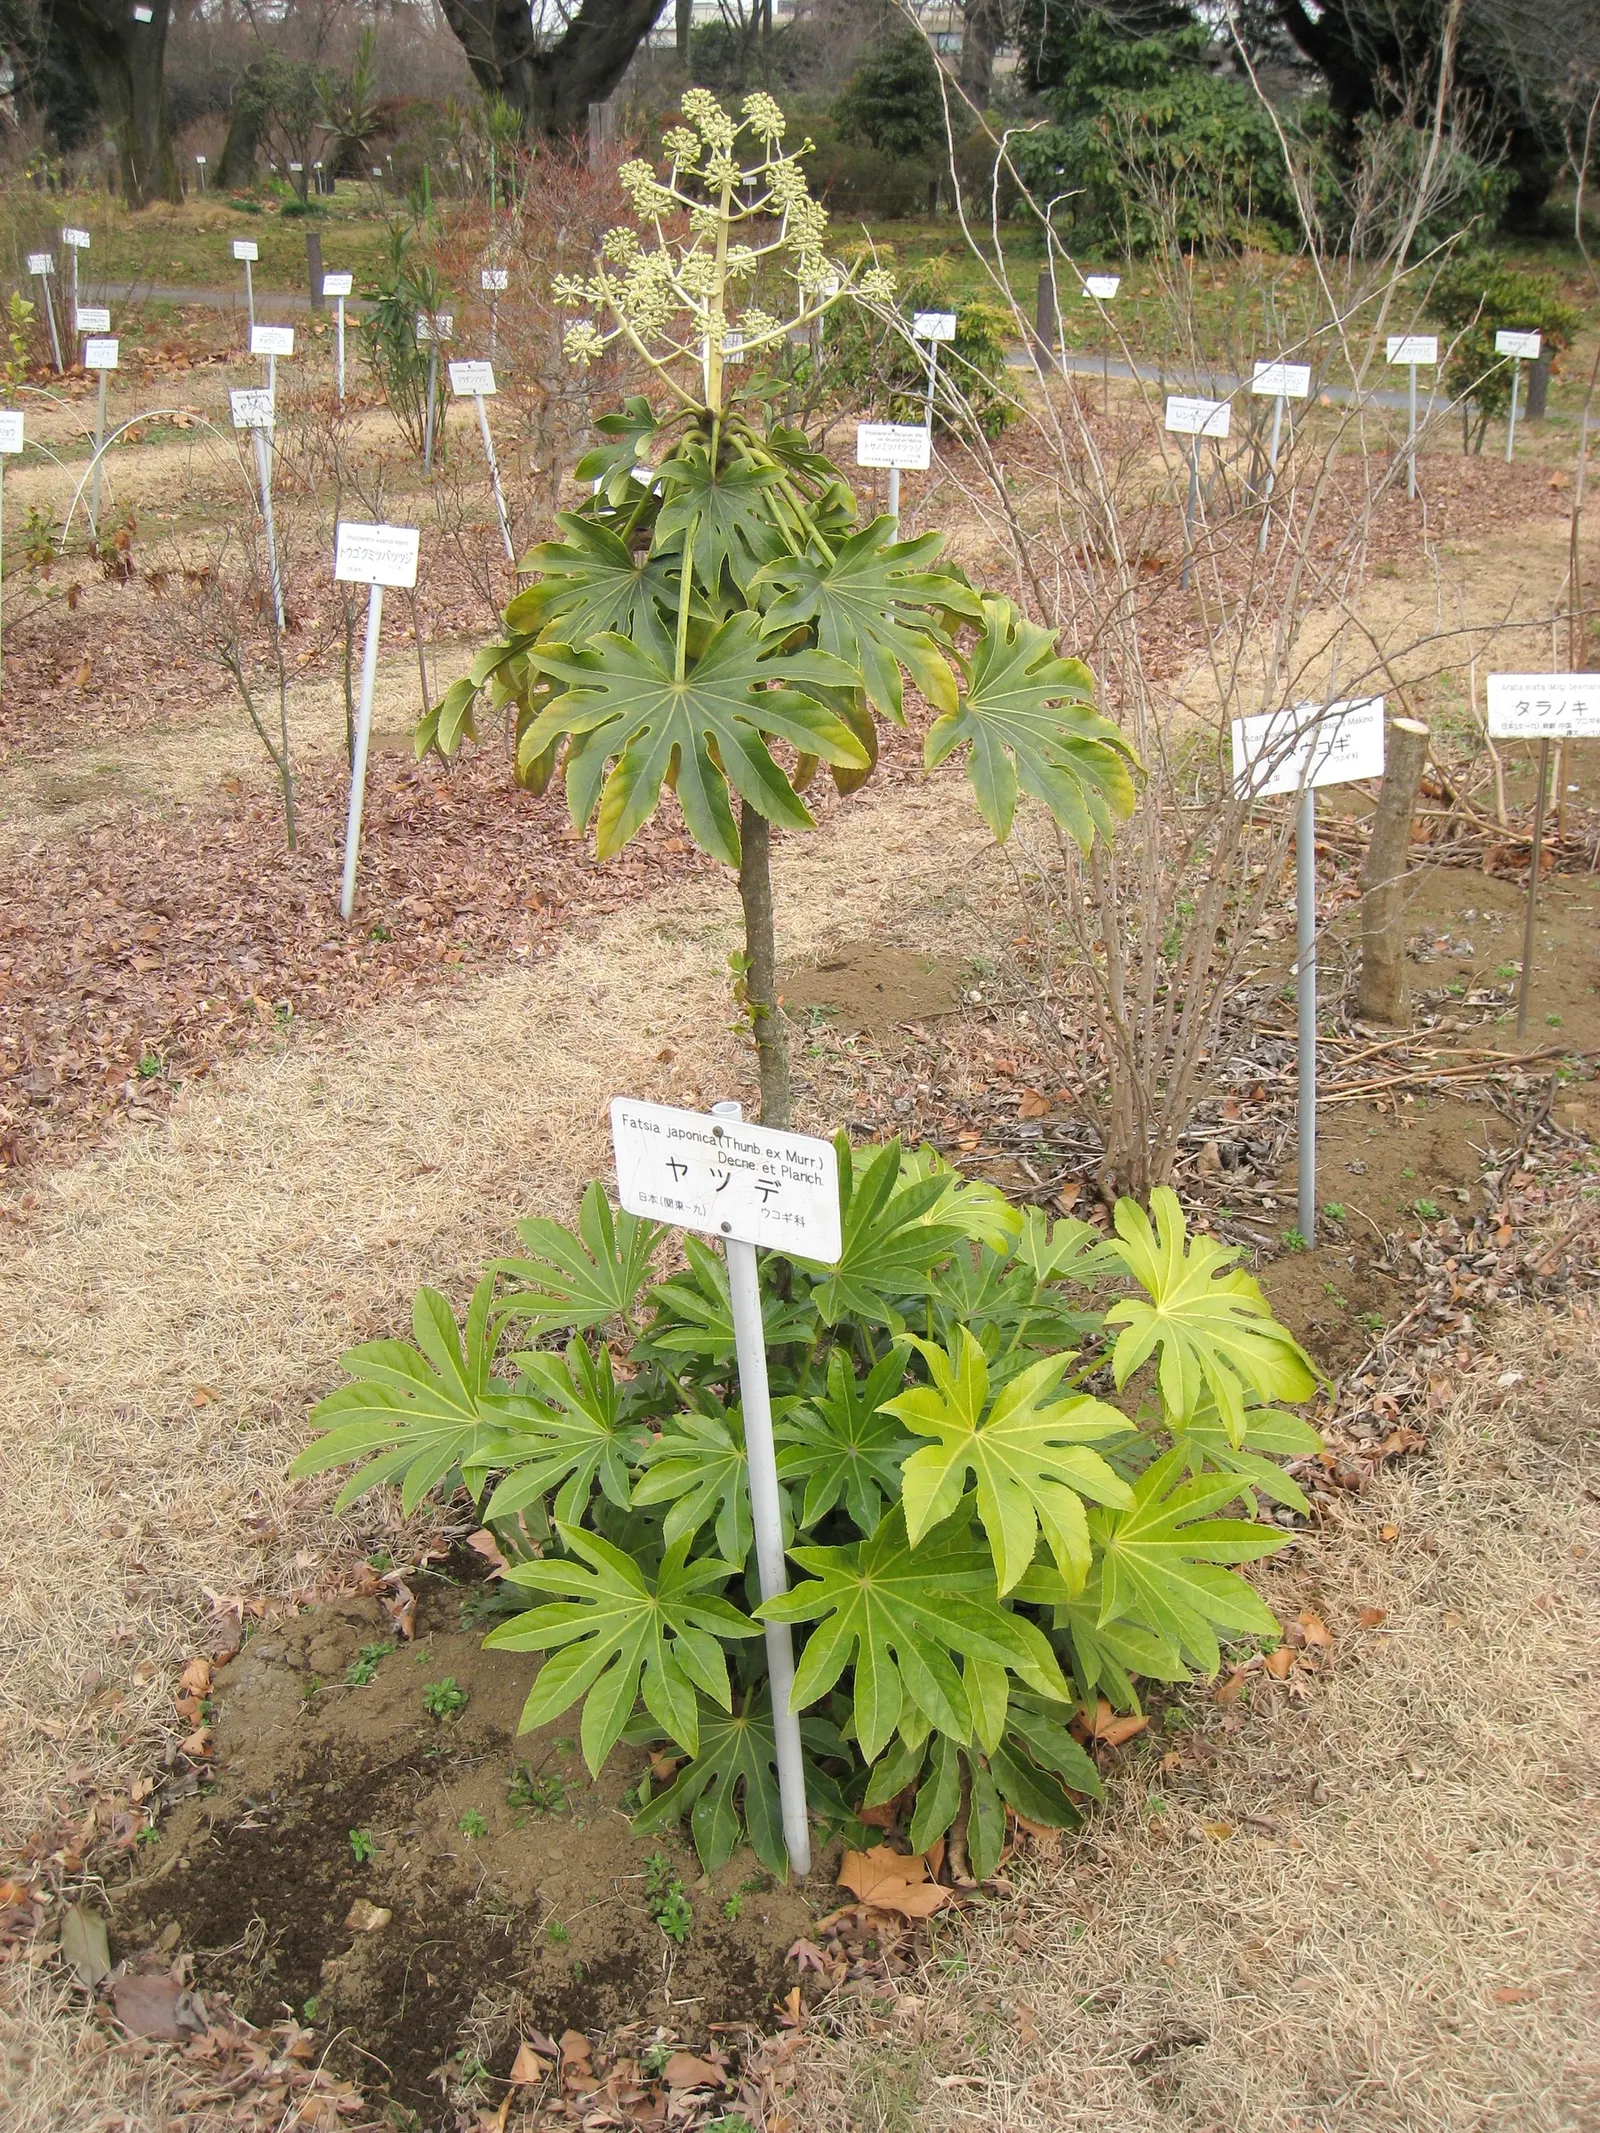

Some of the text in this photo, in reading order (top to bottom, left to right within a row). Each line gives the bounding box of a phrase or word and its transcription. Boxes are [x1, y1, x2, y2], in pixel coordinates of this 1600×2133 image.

[339, 546, 414, 565] トウゴクミツバツツジ
[1515, 700, 1588, 717] タラノキ
[1347, 716, 1374, 726] Makino
[621, 1113, 661, 1134] Fatsia
[666, 1123, 717, 1146] japonica
[765, 1148, 782, 1160] ex
[785, 1149, 824, 1171] Murr.)
[717, 1150, 825, 1186] Decne. et Planch.
[664, 1155, 782, 1204] ヤツデ
[760, 1208, 806, 1228] ウコギ科
